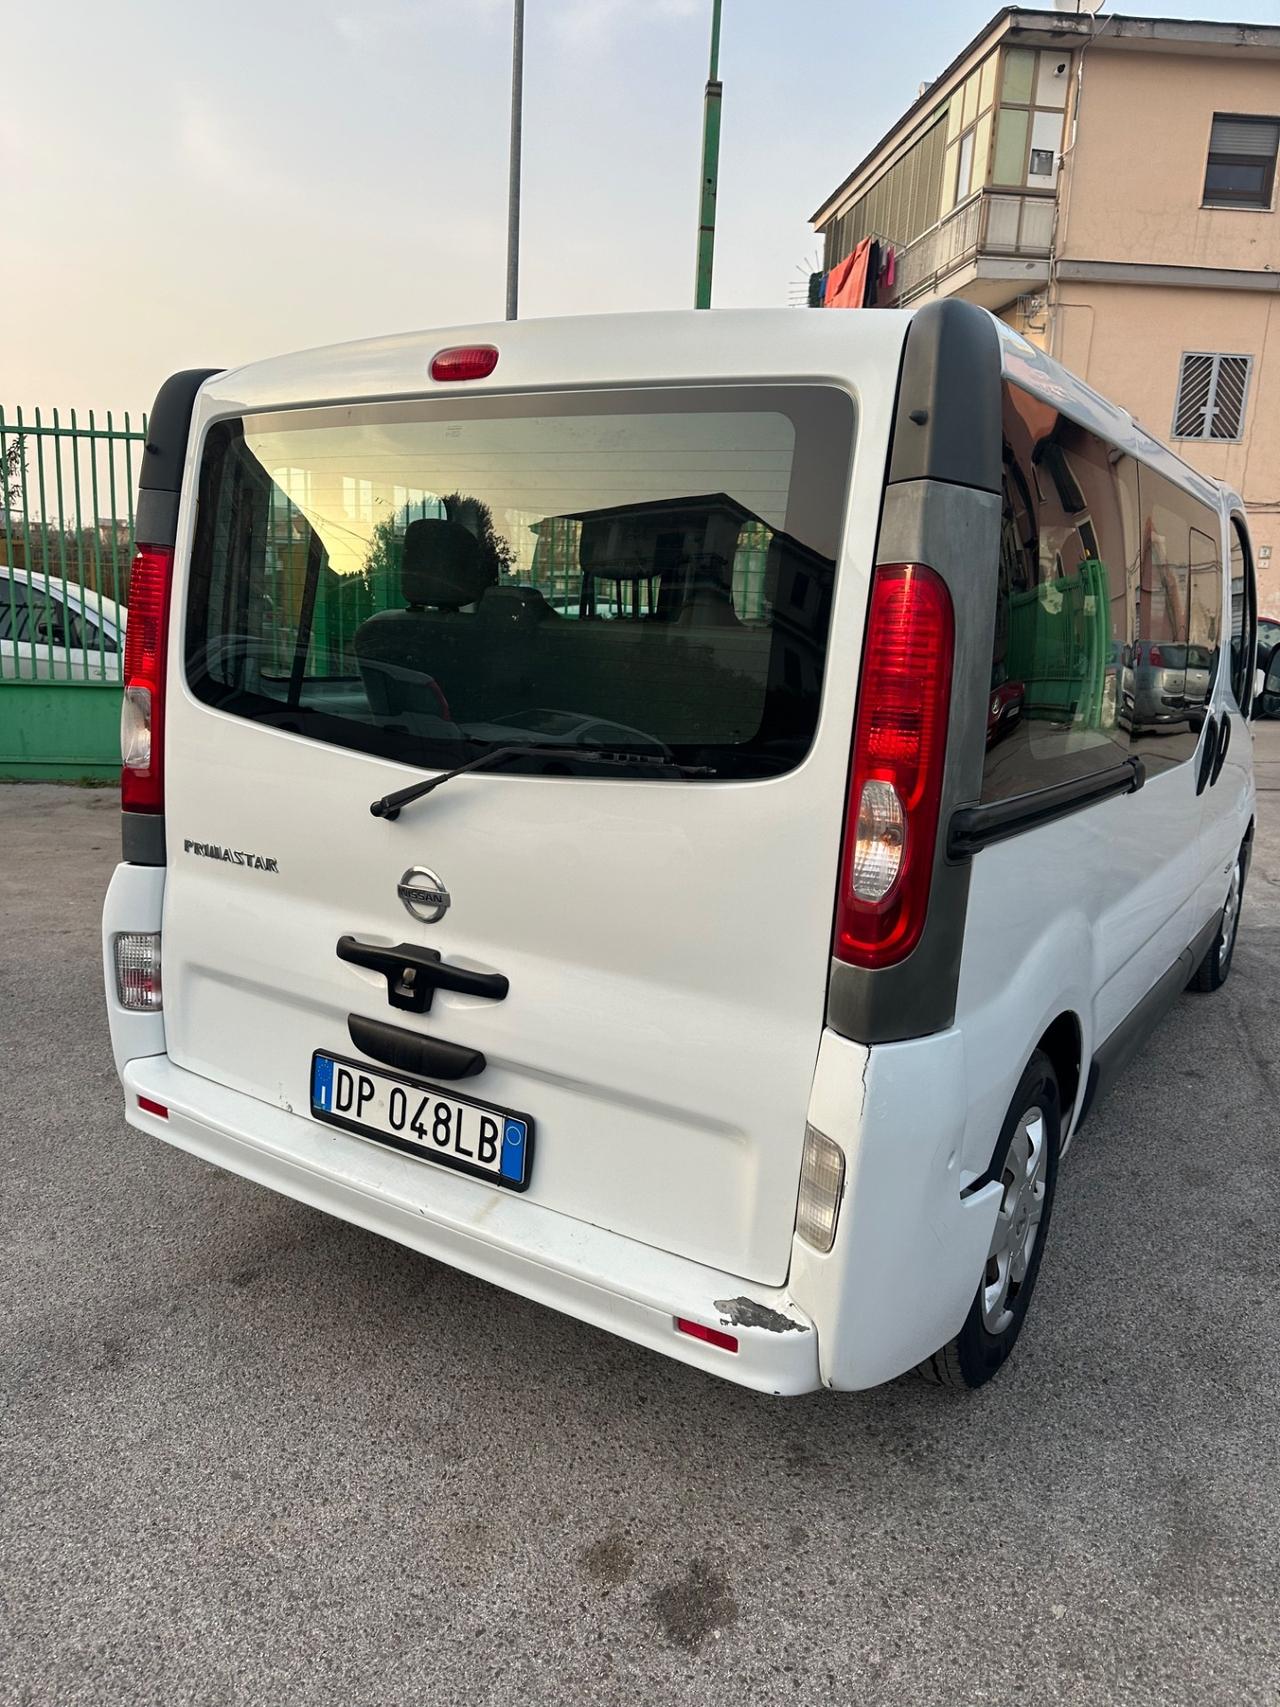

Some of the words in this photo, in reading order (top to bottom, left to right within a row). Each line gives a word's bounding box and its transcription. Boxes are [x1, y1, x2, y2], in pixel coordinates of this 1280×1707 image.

[183, 838, 279, 873] PRIMASTAR
[399, 886, 443, 903] NISSAN
[335, 1067, 376, 1118] DP
[388, 1086, 499, 1164] 048LB
